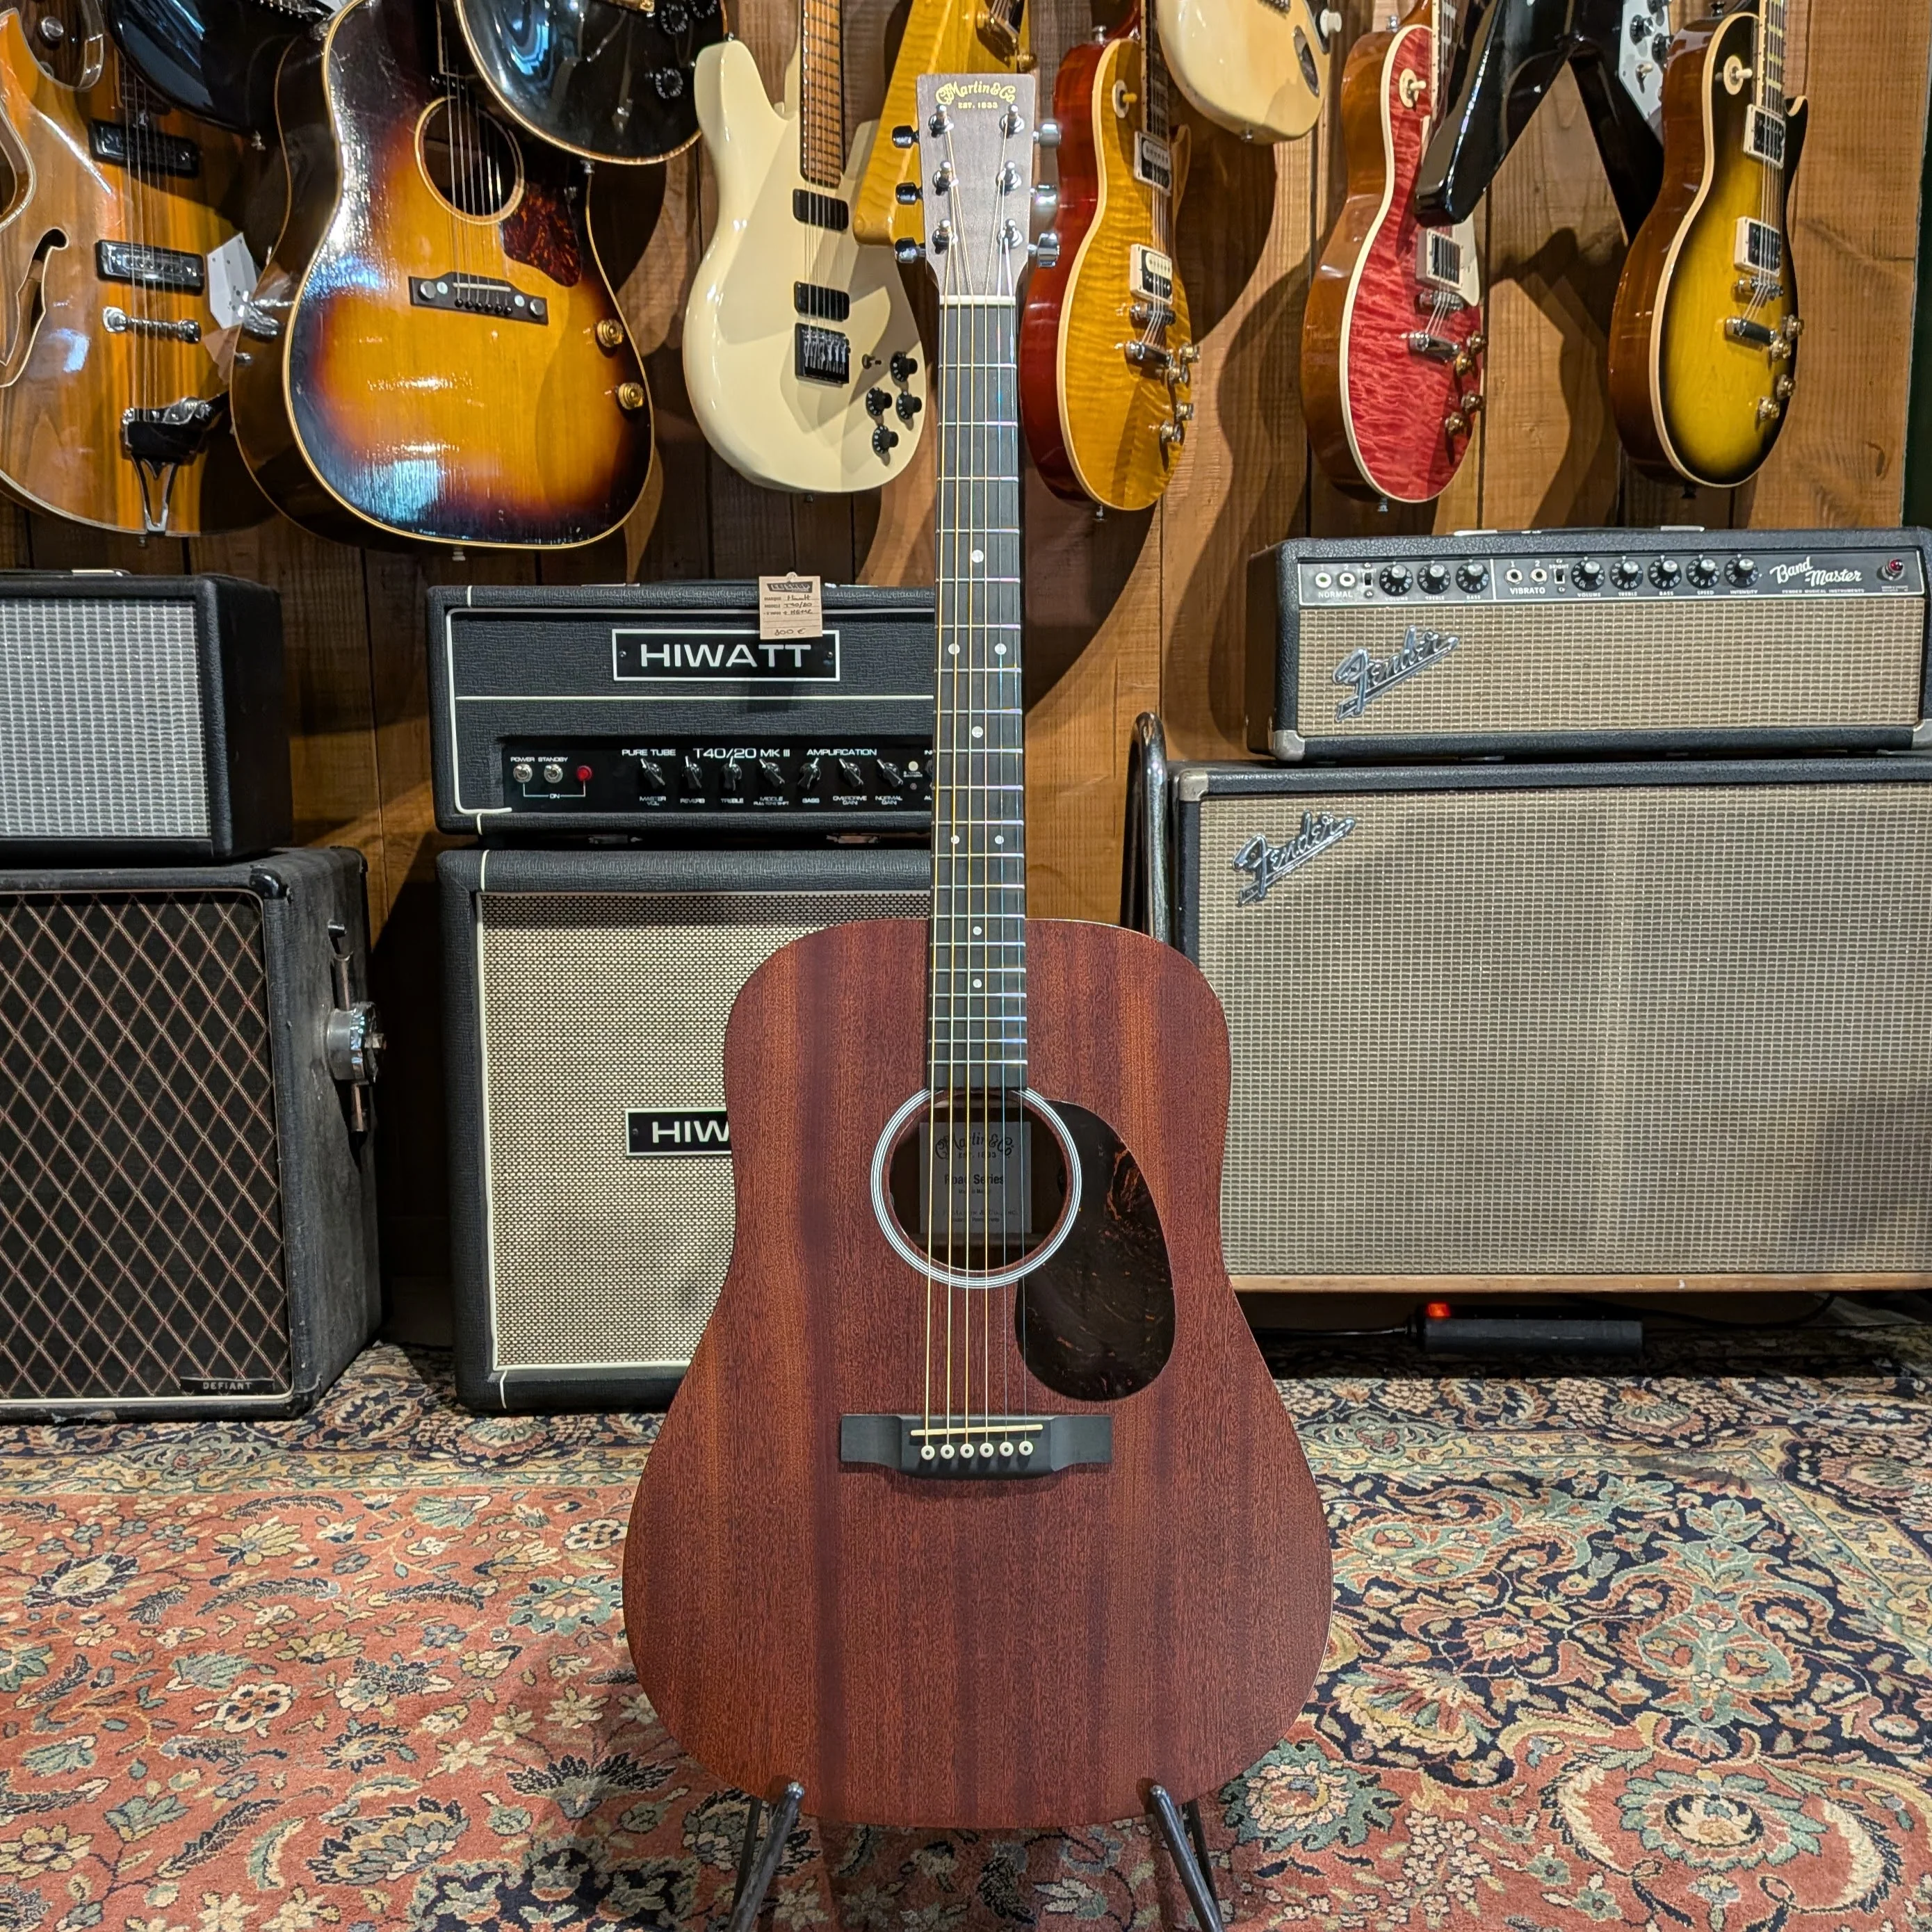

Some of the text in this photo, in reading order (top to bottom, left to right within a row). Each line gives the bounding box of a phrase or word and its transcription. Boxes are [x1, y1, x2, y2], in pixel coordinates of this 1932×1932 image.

[1769, 556, 1814, 584] Band
[1805, 569, 1862, 587] Master
[640, 643, 811, 667] HIWATT
[1333, 624, 1459, 722] Fender
[693, 748, 757, 758] T40/20
[760, 749, 780, 757] MK
[1233, 809, 1355, 905] Fender
[973, 1174, 1004, 1185] Series
[202, 1381, 252, 1390] DEFIANT
